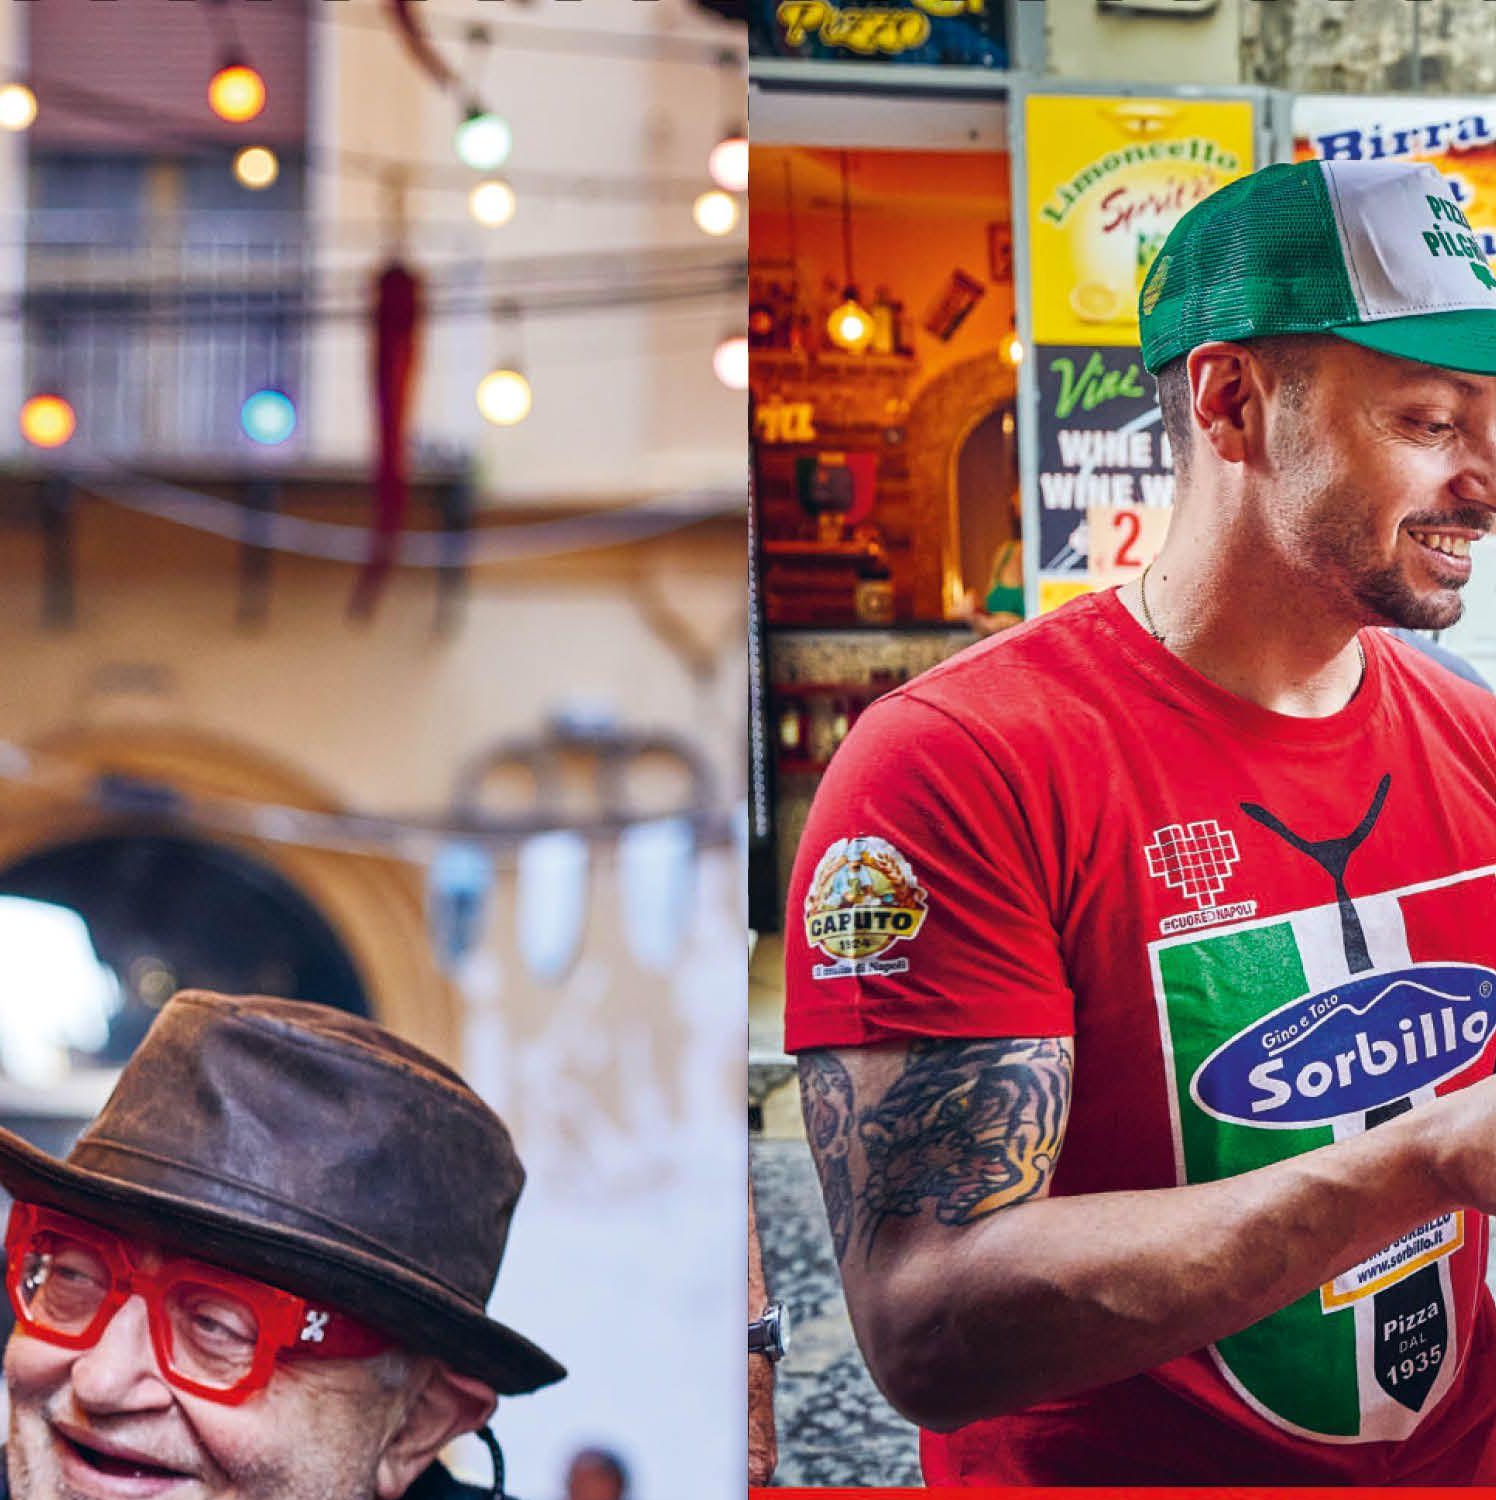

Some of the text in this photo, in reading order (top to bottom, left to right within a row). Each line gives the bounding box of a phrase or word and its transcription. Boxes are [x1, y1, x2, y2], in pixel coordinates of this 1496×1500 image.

[1317, 115, 1490, 161] Birra
[1043, 138, 1239, 224] Limoncello
[1057, 430, 1153, 468] WINE
[1040, 472, 1134, 509] WINE
[811, 910, 914, 937] CAPUTO
[1261, 1023, 1298, 1050] Gino
[1308, 994, 1339, 1019] Toto
[1248, 1006, 1489, 1113] Sorbillo
[1383, 1301, 1440, 1342] Pizza
[1398, 1332, 1428, 1354] DAL
[1386, 1343, 1442, 1386] 1935
